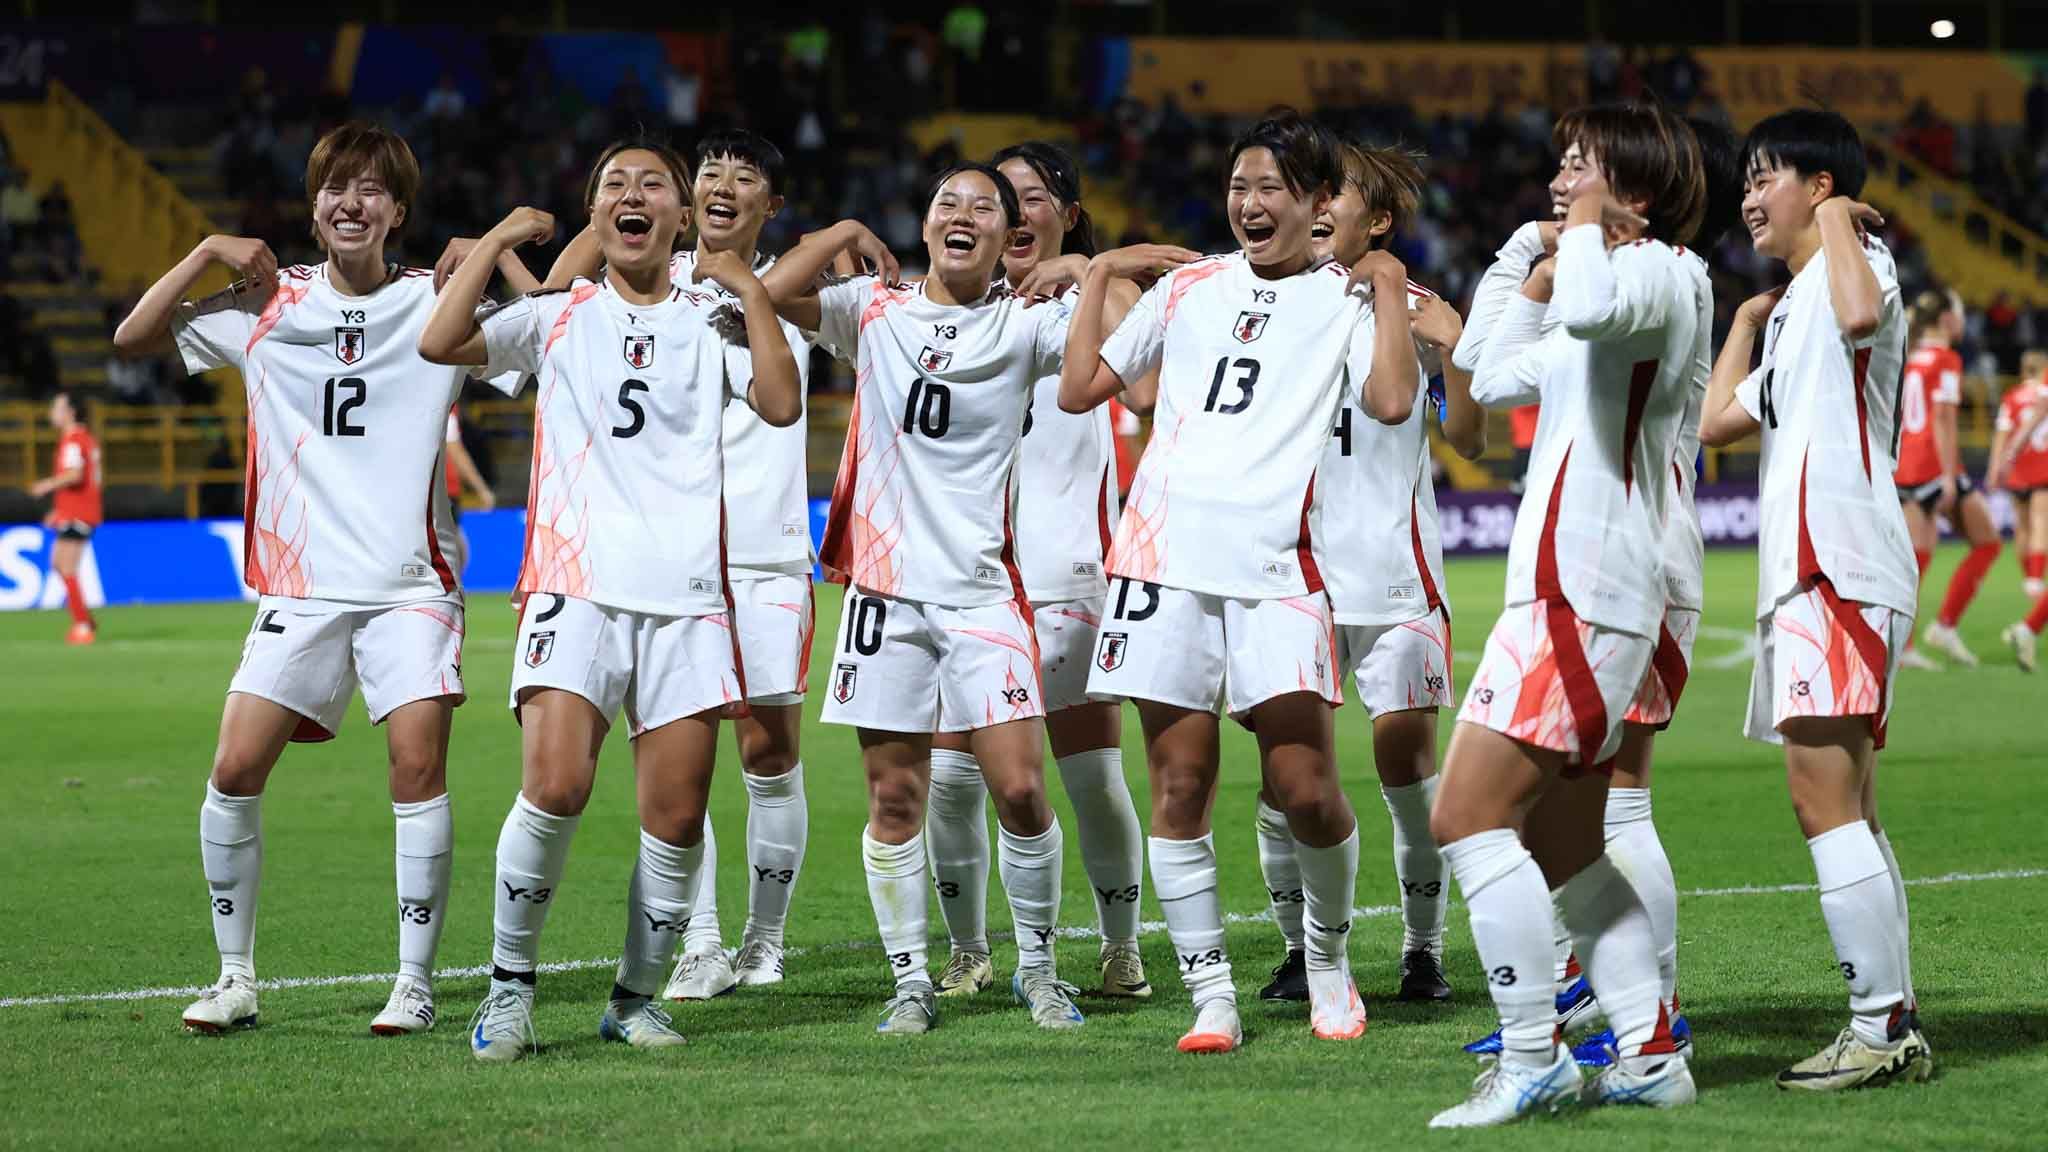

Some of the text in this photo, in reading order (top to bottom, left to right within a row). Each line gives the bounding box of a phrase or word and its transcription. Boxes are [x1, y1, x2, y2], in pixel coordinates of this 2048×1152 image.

[1252, 289, 1276, 304] Y-3
[341, 310, 366, 324] Y-3
[934, 324, 957, 340] Y-3
[1204, 356, 1261, 415] 13
[324, 377, 366, 436] 12
[612, 379, 650, 439] 5
[903, 377, 951, 439] 10
[844, 594, 887, 656] 10
[1425, 676, 1444, 689] Y-3
[1001, 688, 1029, 704] Y-3
[754, 865, 794, 884] Y-3
[504, 880, 551, 904] Y-3
[934, 878, 959, 898] -3
[1097, 884, 1139, 905] Y-3
[1267, 887, 1305, 904] Y-3
[1401, 879, 1442, 898] Y-3
[210, 895, 234, 916] -3
[399, 904, 431, 925] Y-3
[888, 952, 912, 968] -3
[1182, 949, 1221, 971] Y-3
[1489, 966, 1517, 986] -3
